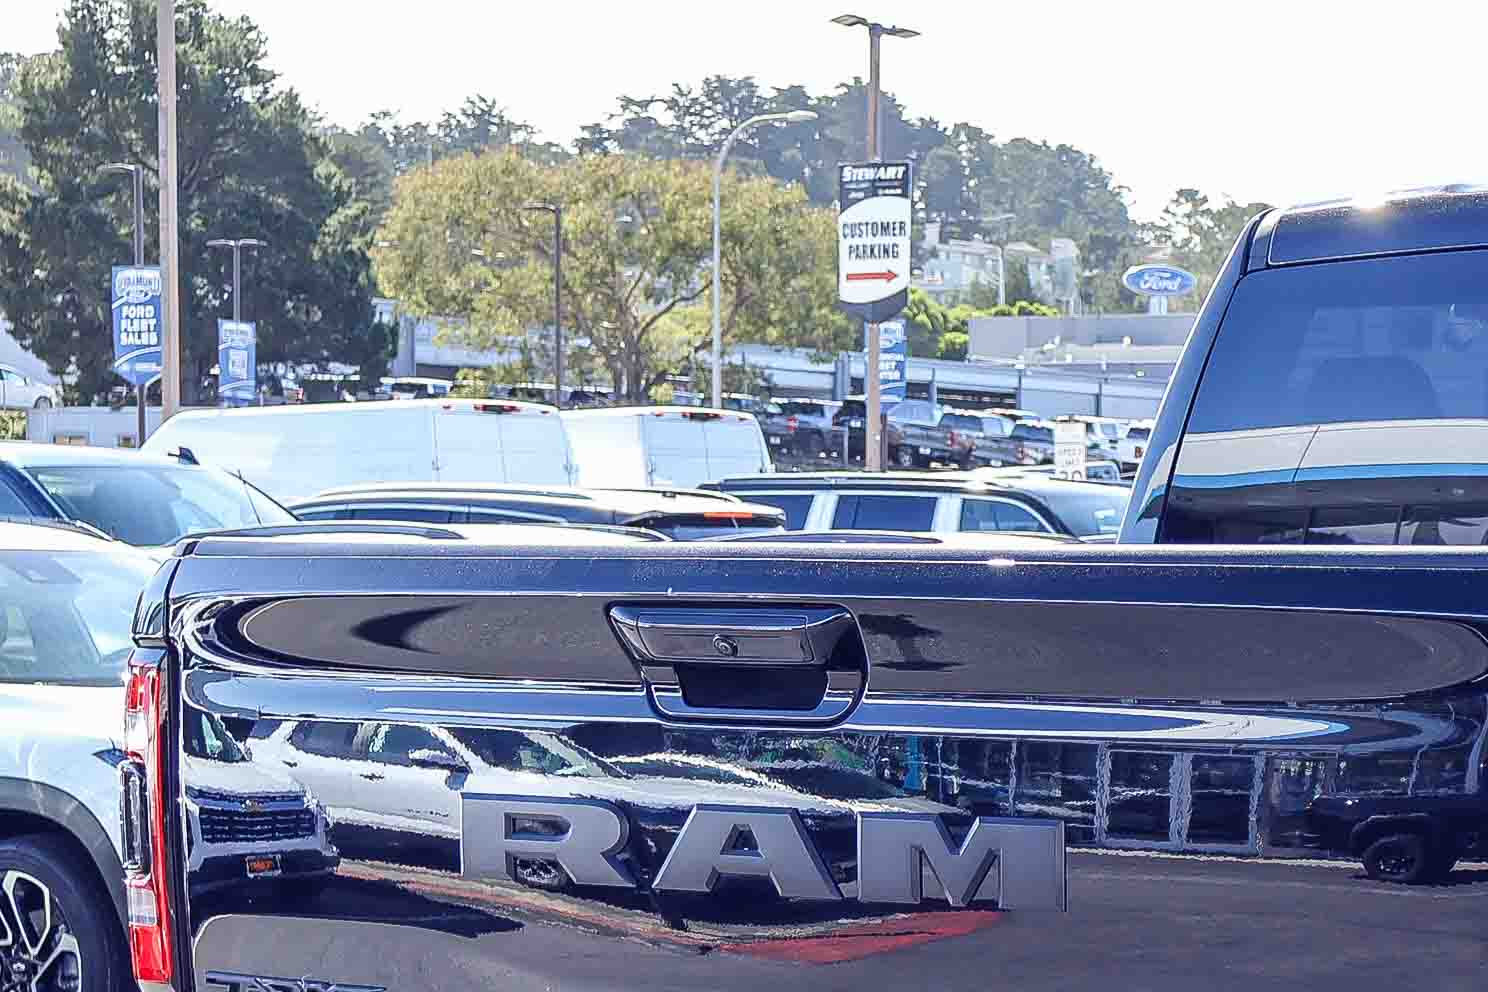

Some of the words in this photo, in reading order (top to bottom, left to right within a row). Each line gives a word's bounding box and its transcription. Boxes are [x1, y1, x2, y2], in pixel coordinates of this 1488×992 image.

[841, 166, 906, 182] STEWART
[842, 221, 907, 239] CUSTOMER
[848, 243, 900, 260] PARKING
[1139, 270, 1184, 291] Ford
[121, 304, 155, 318] FORD
[120, 332, 158, 346] SALES
[460, 791, 1068, 913] RAM
